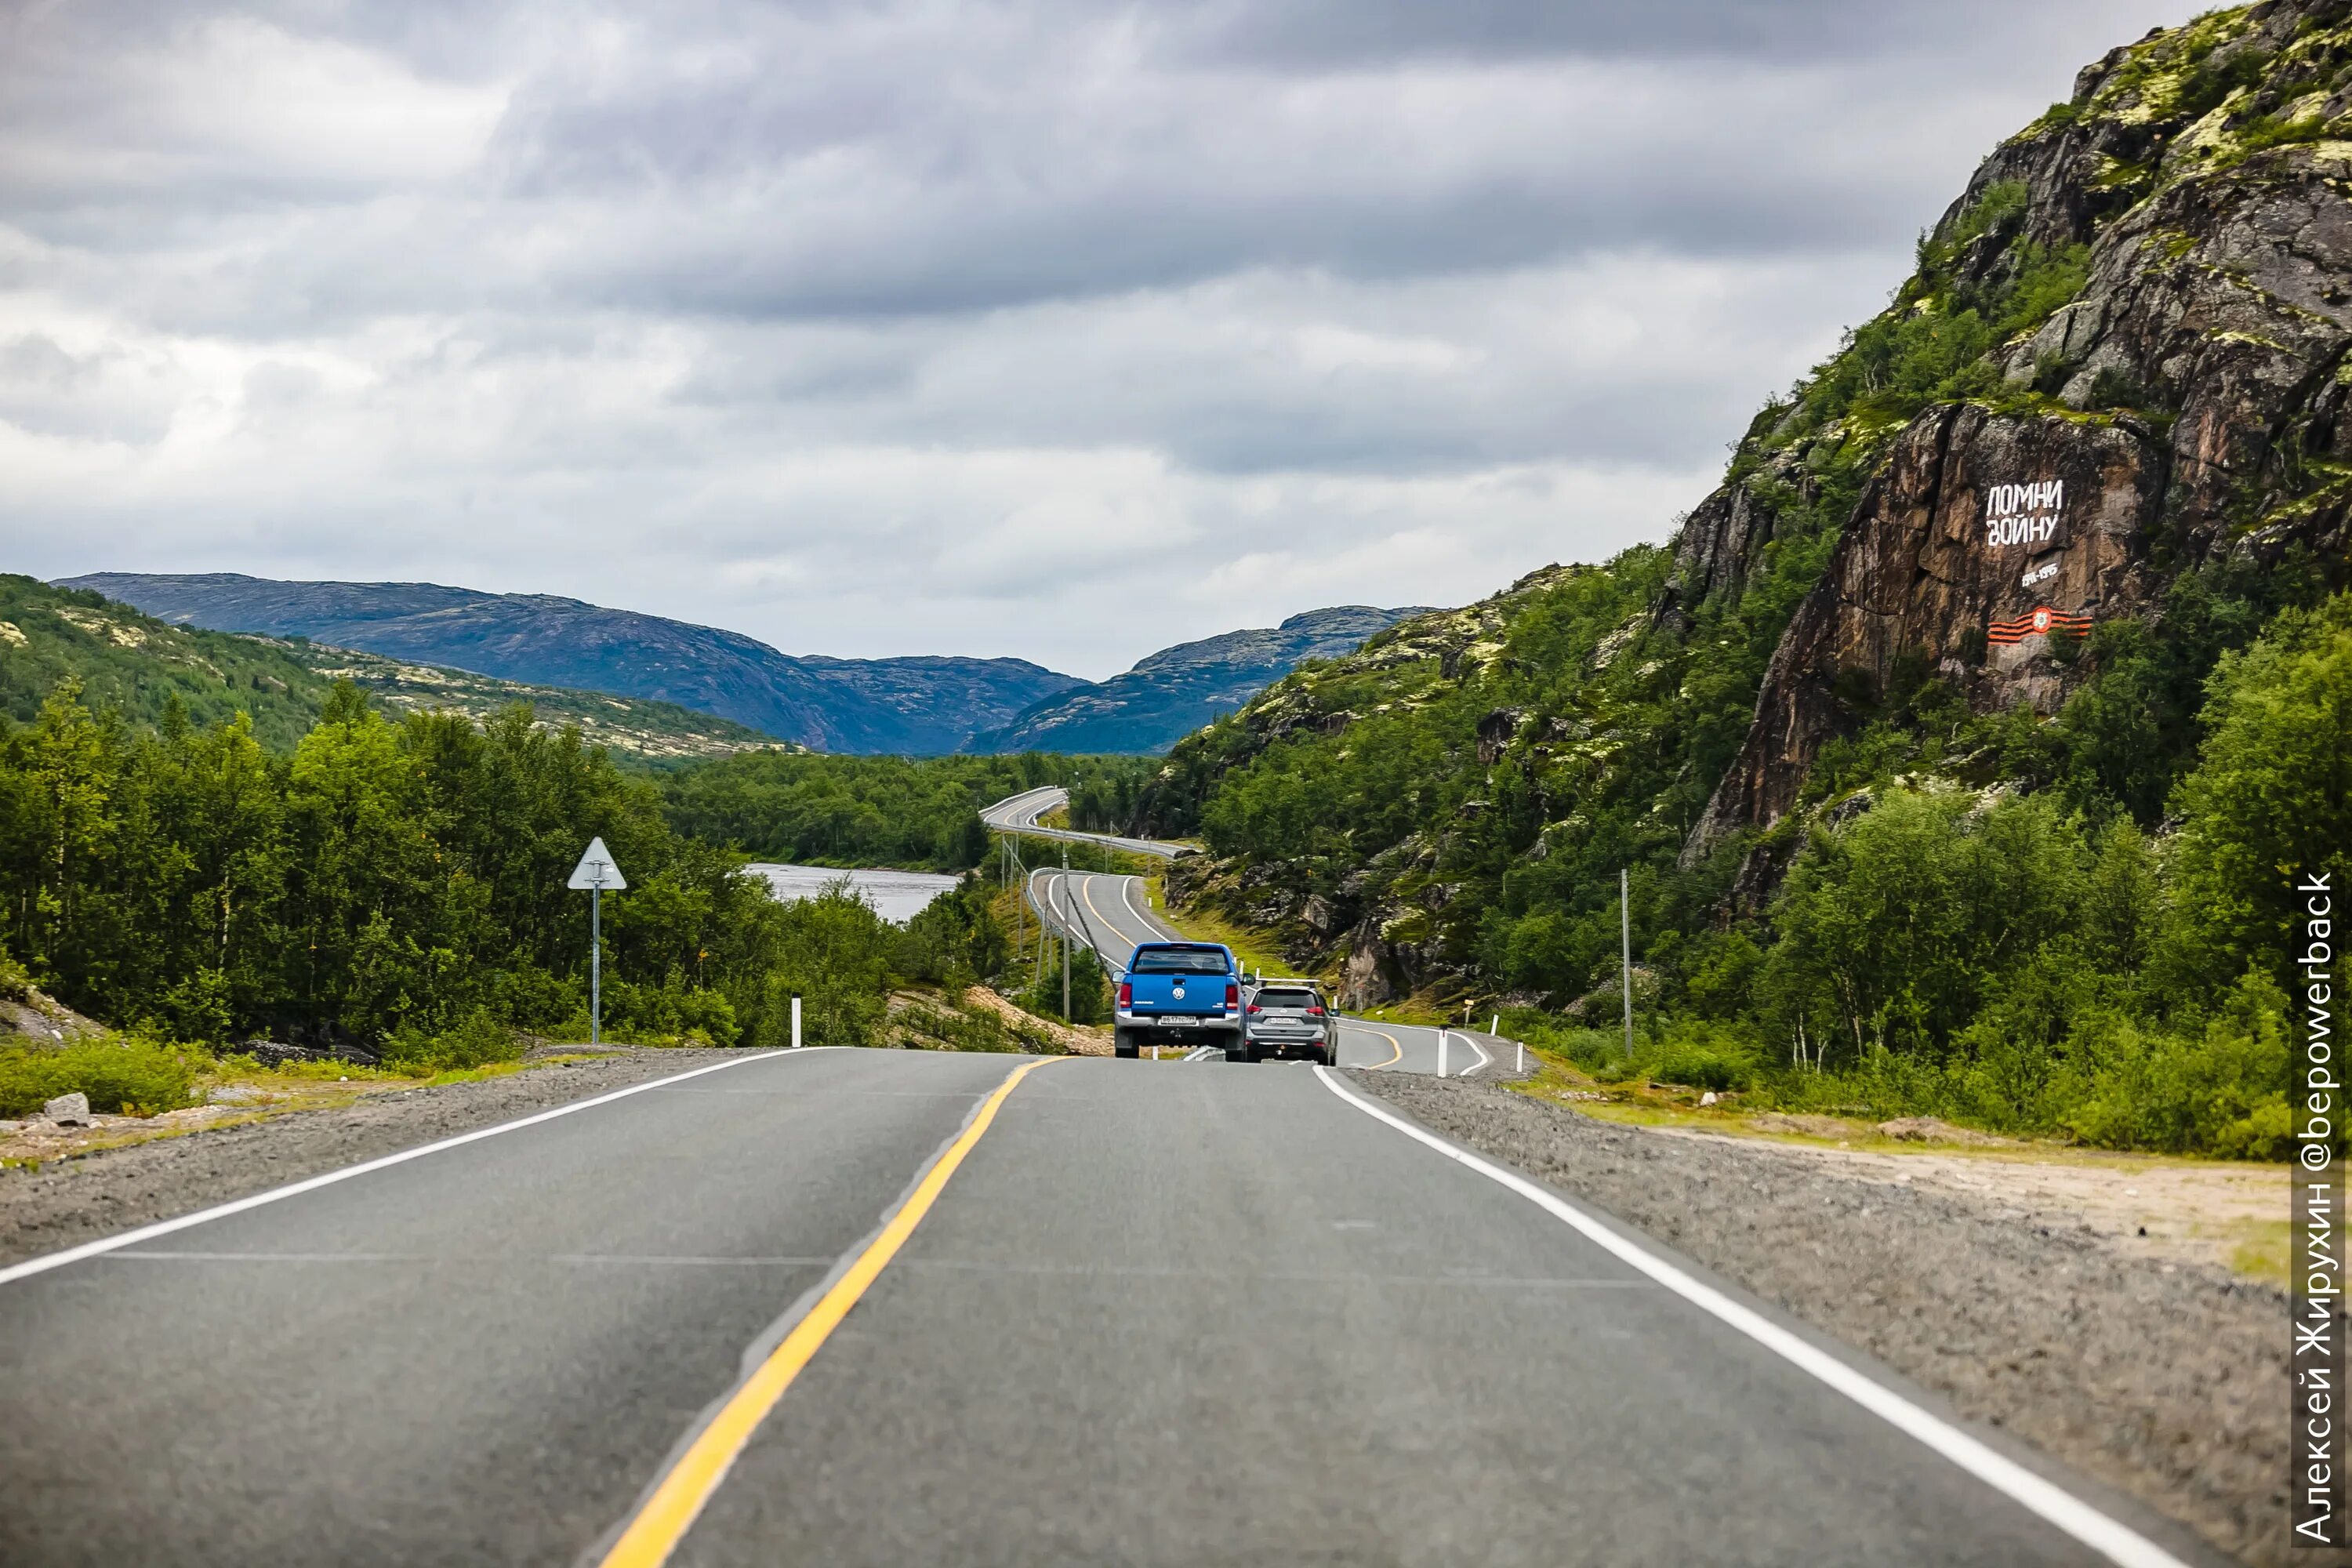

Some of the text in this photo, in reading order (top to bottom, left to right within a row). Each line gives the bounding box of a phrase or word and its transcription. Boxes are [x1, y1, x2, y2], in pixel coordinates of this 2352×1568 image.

[1986, 479, 2063, 517] ПОМНИ
[1986, 514, 2059, 546] ВОЙНУ
[2022, 563, 2058, 587] 1941-1945
